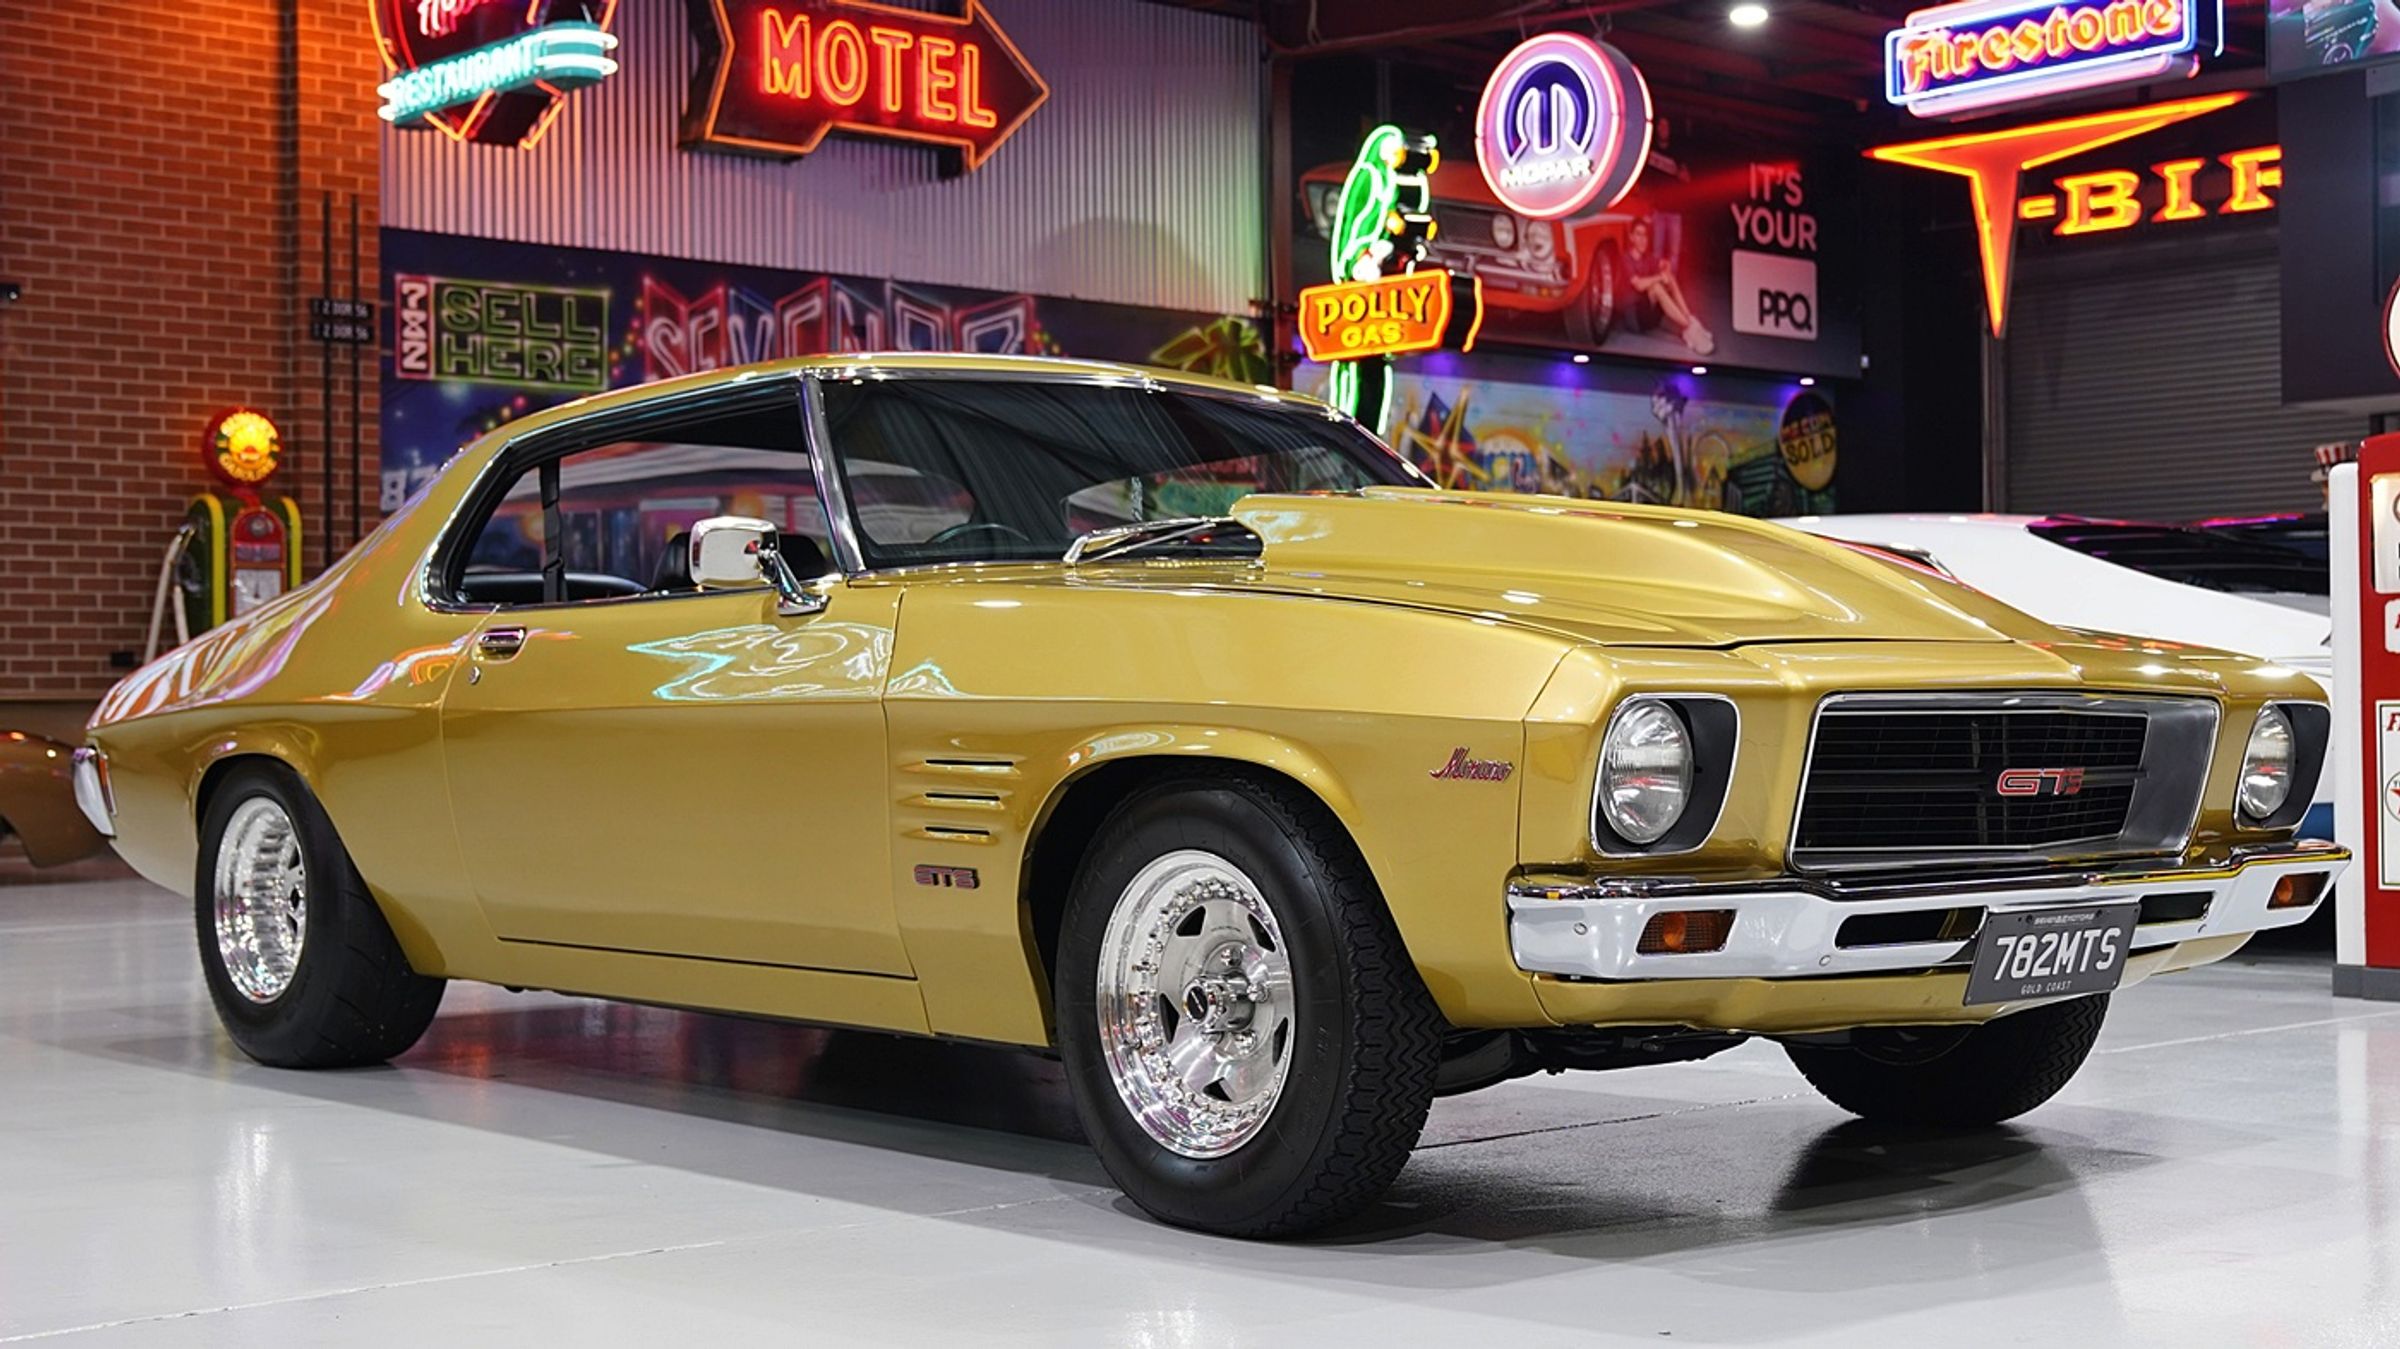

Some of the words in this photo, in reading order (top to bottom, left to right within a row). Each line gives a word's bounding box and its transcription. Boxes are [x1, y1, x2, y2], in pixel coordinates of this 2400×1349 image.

[762, 8, 998, 128] MOTEL
[1897, 0, 2181, 93] Firestone
[391, 33, 540, 114] RESTAURANT
[1499, 155, 1596, 188] MOPAR
[1750, 162, 1804, 207] IT'S
[1731, 203, 1818, 252] YOUR
[442, 285, 602, 342] SELL
[1315, 284, 1431, 334] POLLY
[1758, 287, 1813, 332] PPQ
[442, 332, 603, 384] HERE
[1340, 321, 1402, 348] GAS
[1785, 432, 1835, 467] SOLD
[1996, 767, 2085, 796] GTS
[914, 863, 980, 890] GTS
[1994, 926, 2122, 981] 782MTS
[2020, 983, 2042, 996] GOLD
[2046, 980, 2073, 993] COAST
